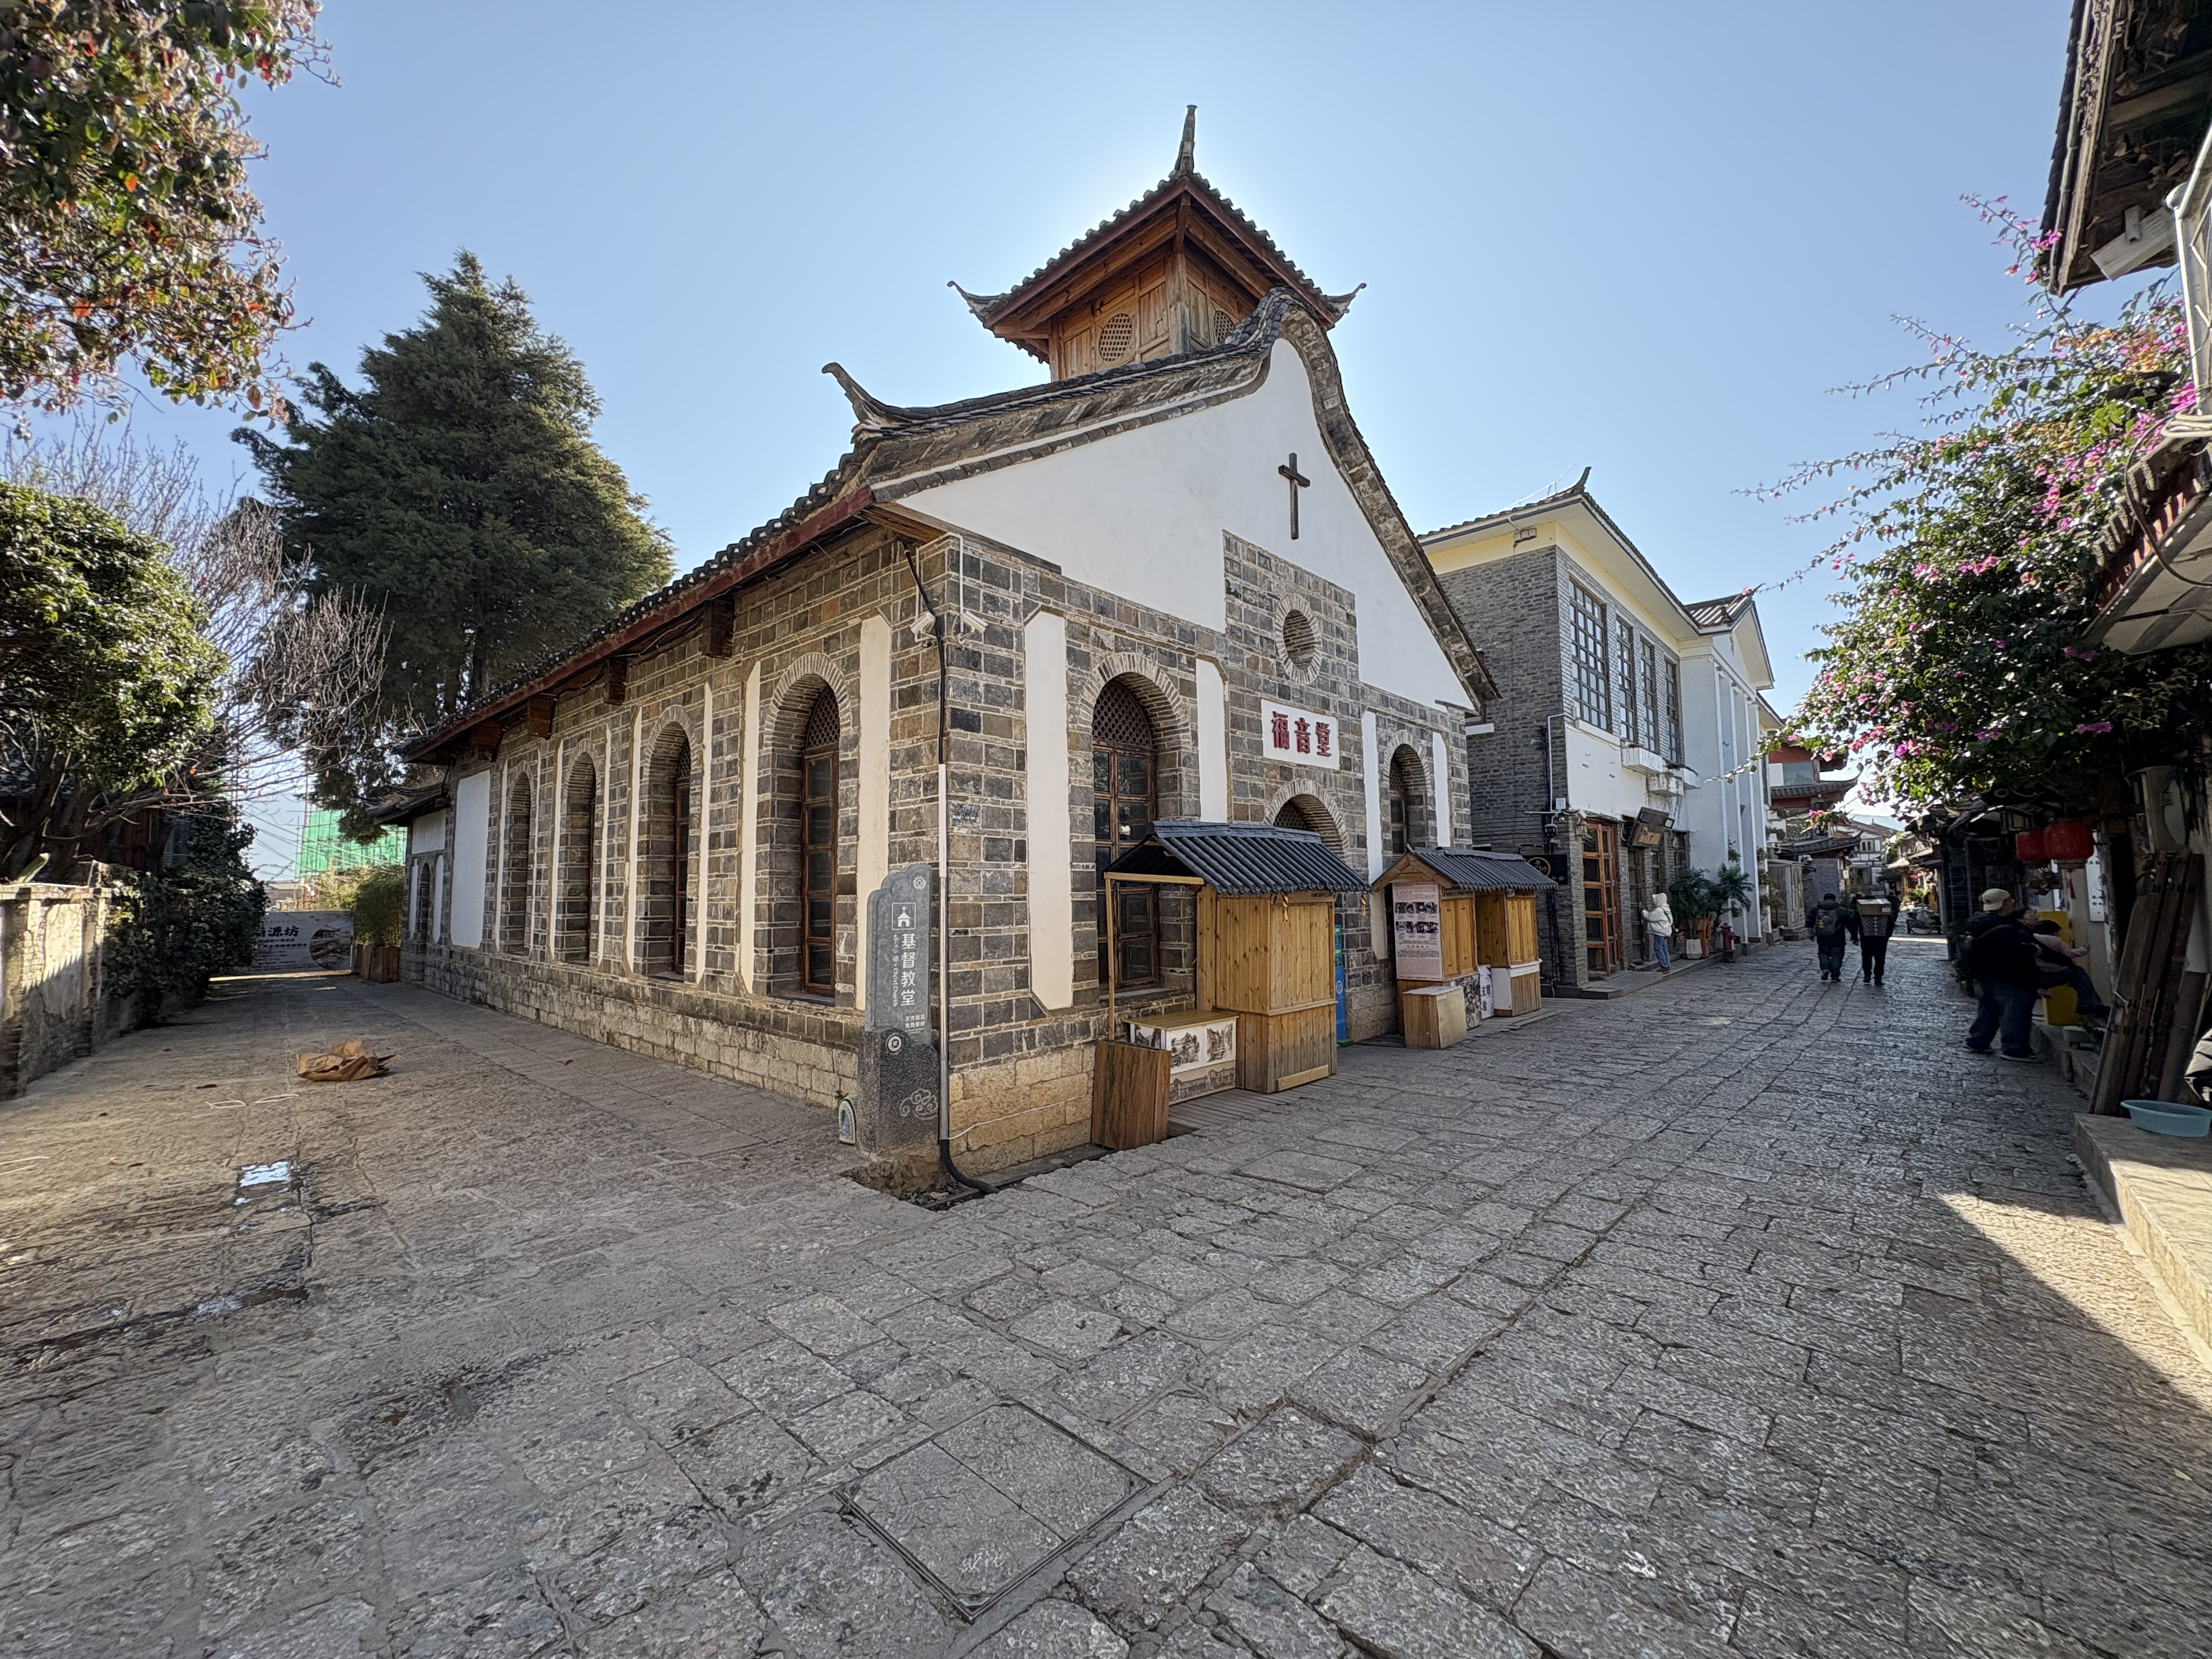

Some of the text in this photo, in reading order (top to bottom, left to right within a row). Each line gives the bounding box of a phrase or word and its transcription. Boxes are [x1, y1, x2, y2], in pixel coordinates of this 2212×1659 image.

[1271, 711, 1332, 757] 福音堂
[900, 933, 916, 1006] 基督教堂
